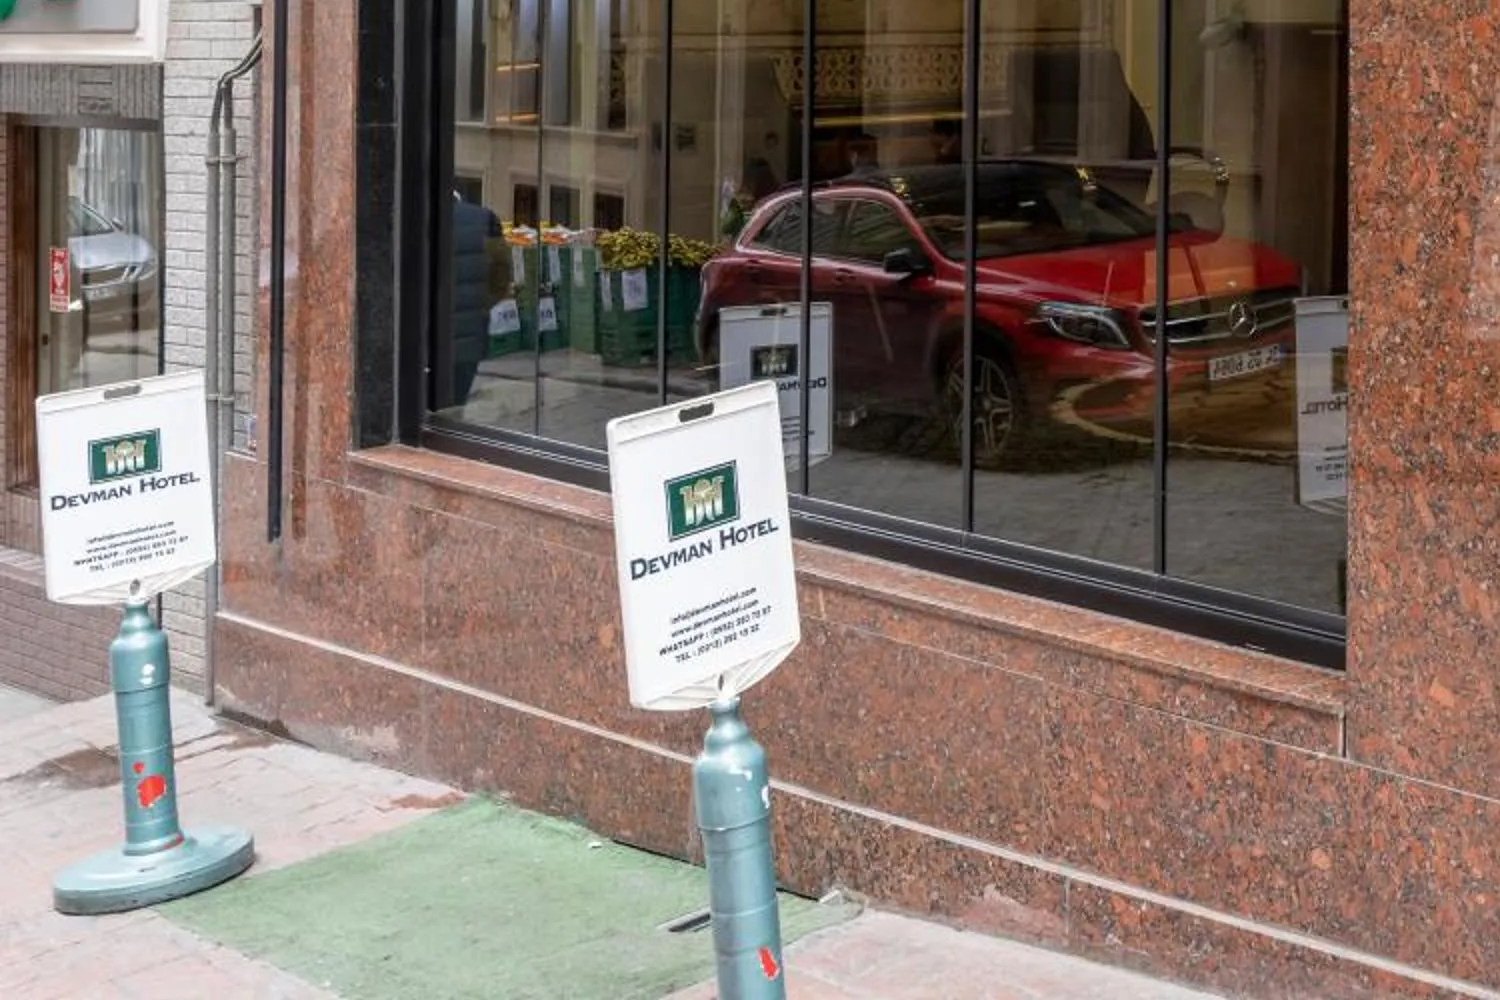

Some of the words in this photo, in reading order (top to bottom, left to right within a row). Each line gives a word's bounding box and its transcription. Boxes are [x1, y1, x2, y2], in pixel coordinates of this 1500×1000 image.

[51, 485, 132, 511] DEVMAN
[139, 472, 200, 493] HOTEL
[630, 539, 713, 581] DEVMAN
[719, 518, 779, 550] HOTEL
